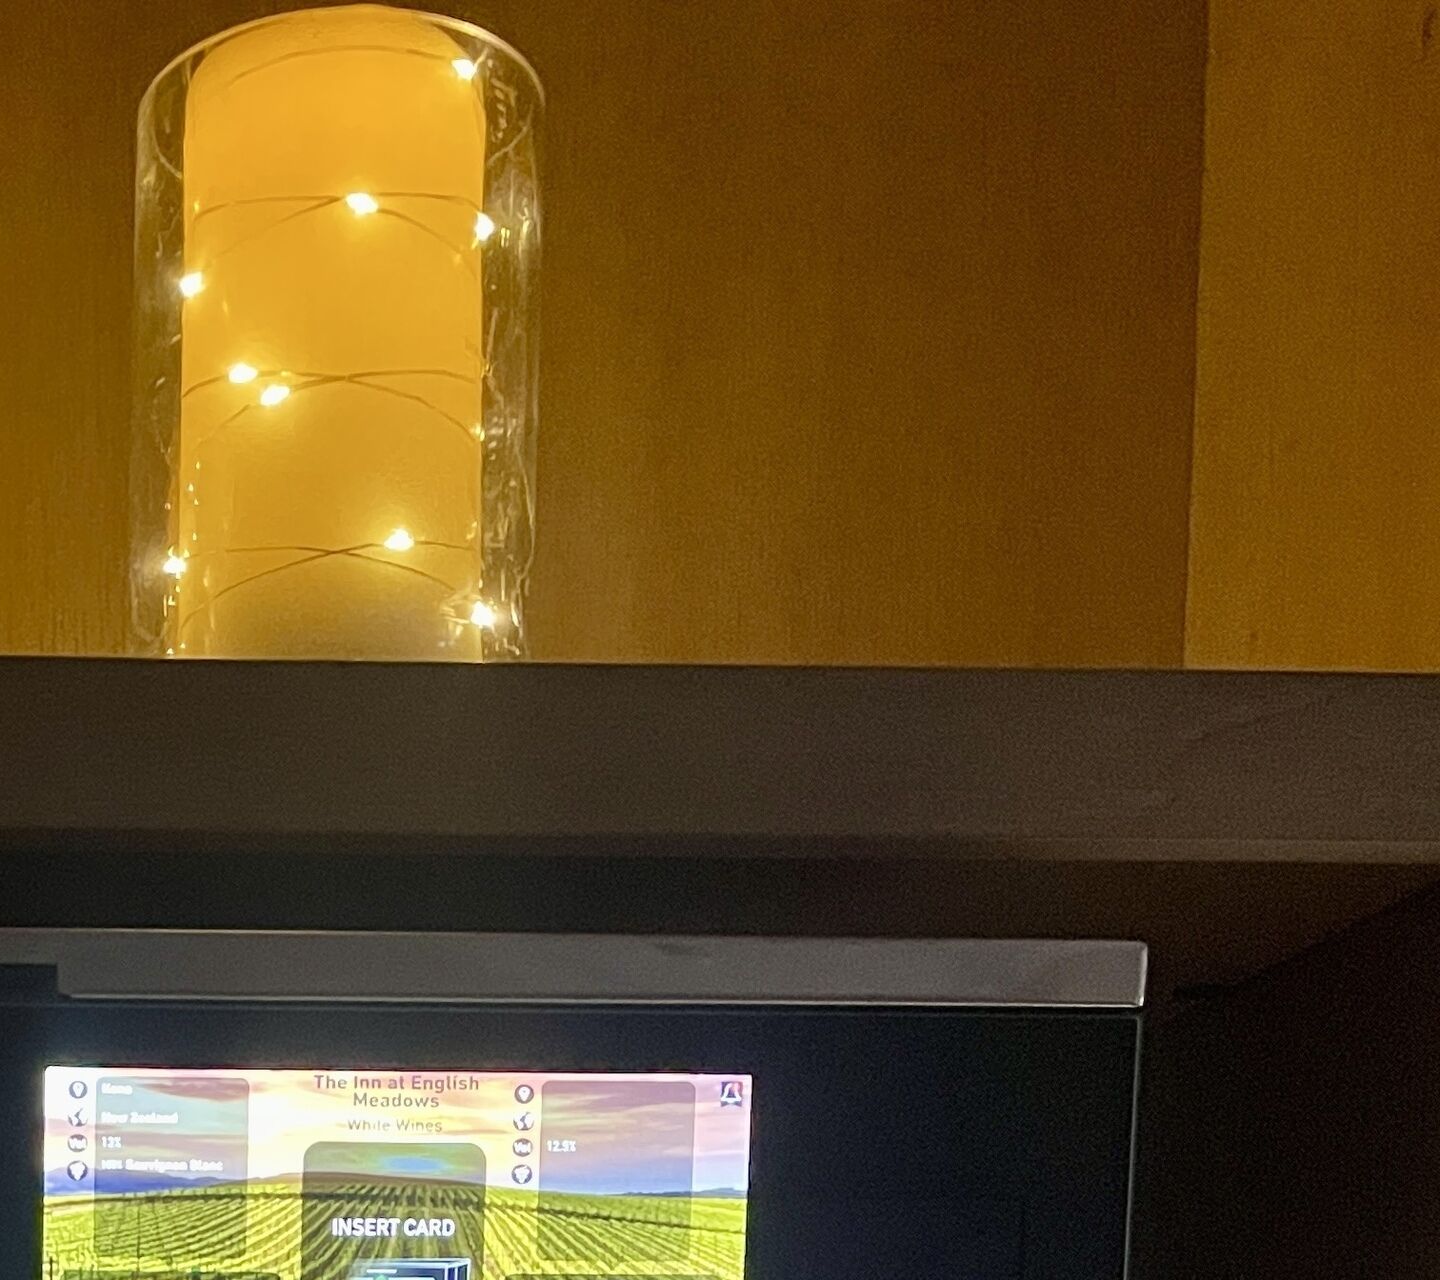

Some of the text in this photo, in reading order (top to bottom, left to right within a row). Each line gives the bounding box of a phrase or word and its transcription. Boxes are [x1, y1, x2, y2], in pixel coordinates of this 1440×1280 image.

[314, 1075, 479, 1093] The Inn at English
[353, 1093, 440, 1108] Meadows
[396, 1120, 443, 1133] Wines
[331, 1217, 456, 1237] INSERT CARD
